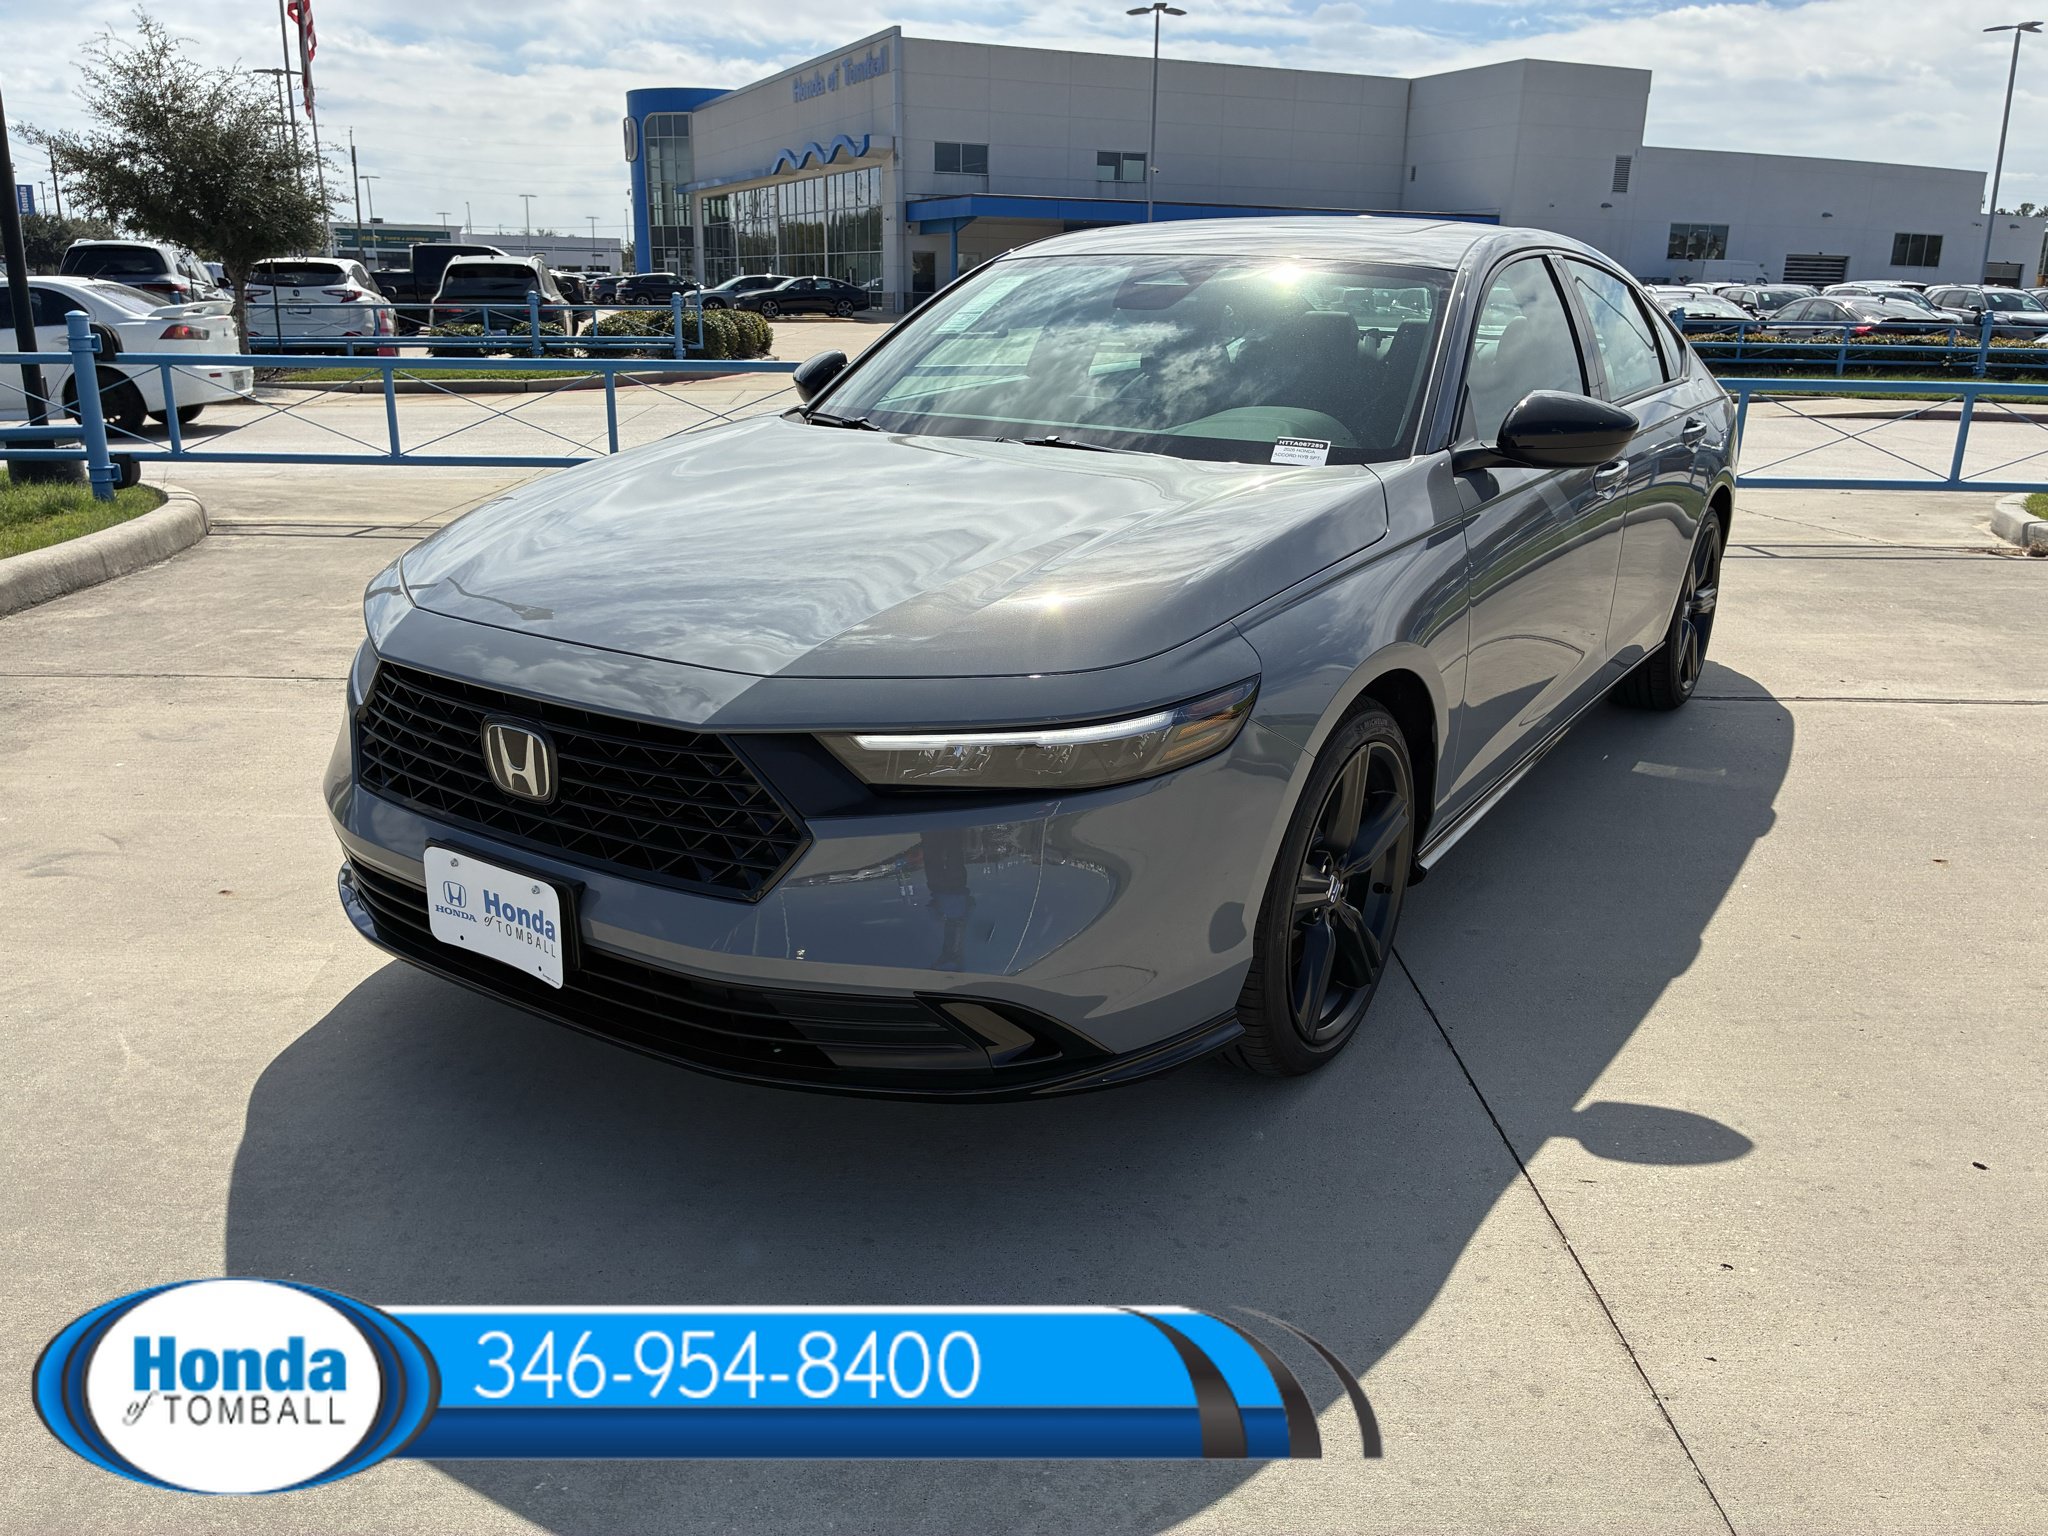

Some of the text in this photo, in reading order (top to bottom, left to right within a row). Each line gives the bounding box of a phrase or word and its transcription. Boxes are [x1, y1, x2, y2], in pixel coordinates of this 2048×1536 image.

[793, 43, 890, 103] Honda of Tomball
[435, 904, 477, 923] HONDA
[482, 889, 556, 942] Honda
[484, 915, 556, 959] of TOMBALL
